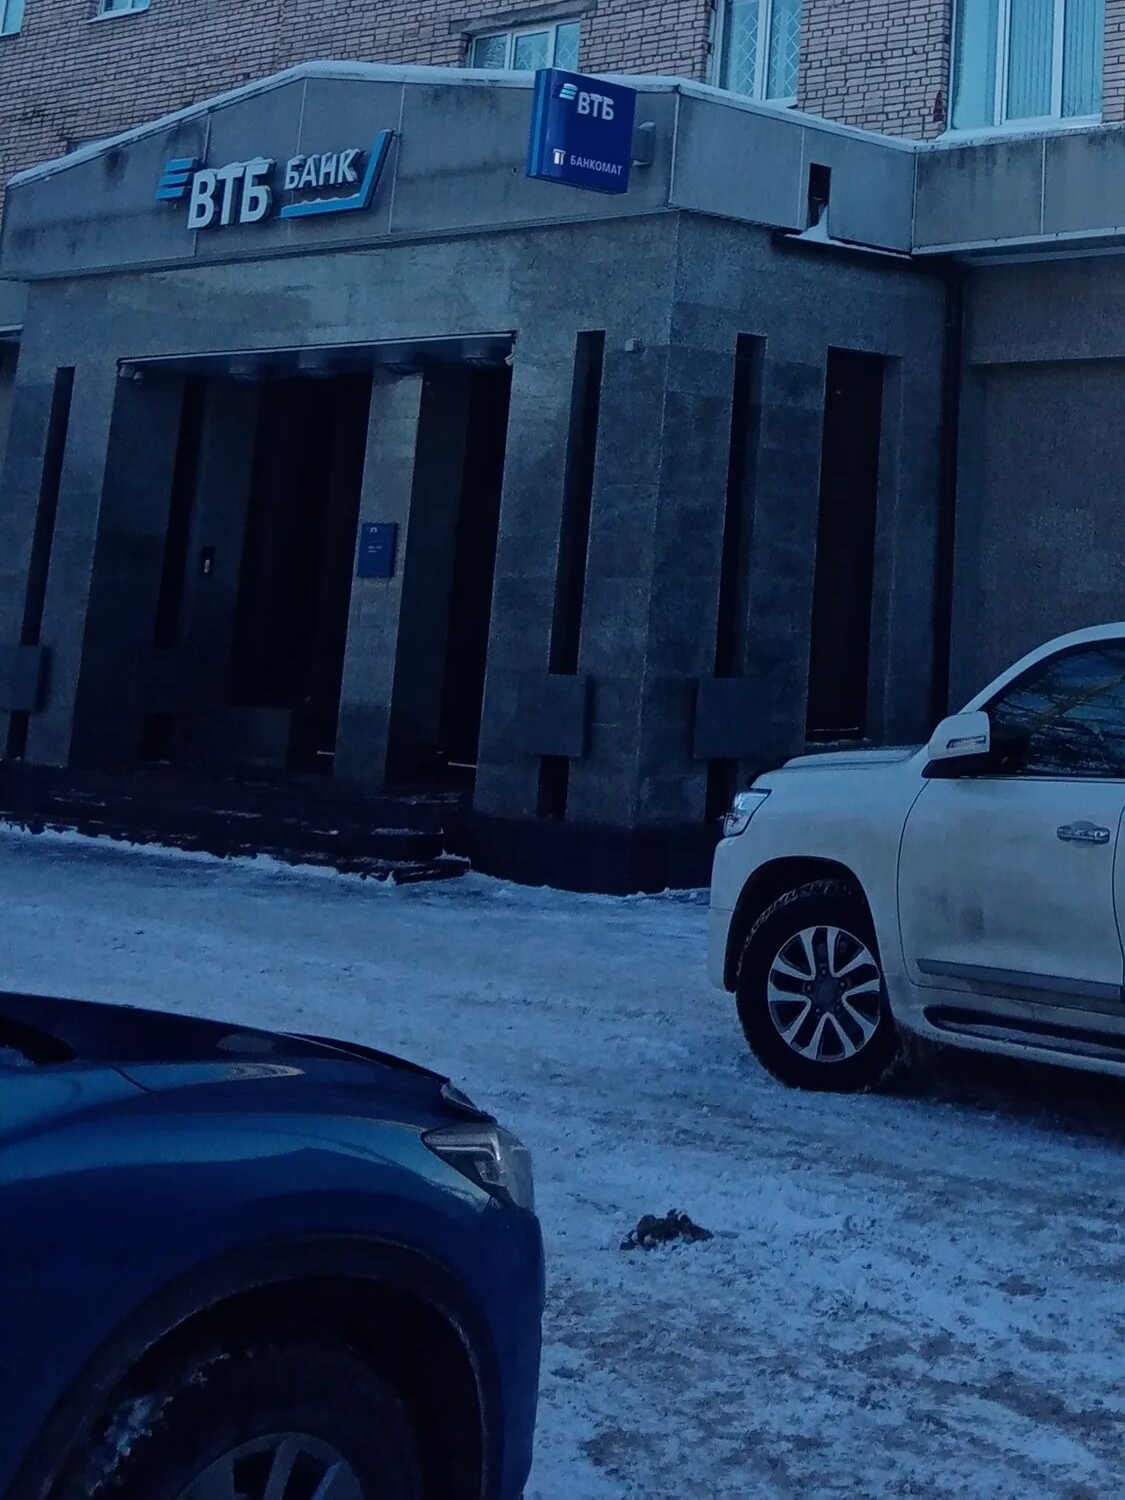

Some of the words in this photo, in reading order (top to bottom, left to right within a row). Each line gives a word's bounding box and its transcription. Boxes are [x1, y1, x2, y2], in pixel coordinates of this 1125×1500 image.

[577, 91, 615, 120] ВТБ
[570, 155, 622, 175] БАНКОМАТ
[187, 158, 274, 229] ВТБ
[284, 148, 361, 190] БАНК
